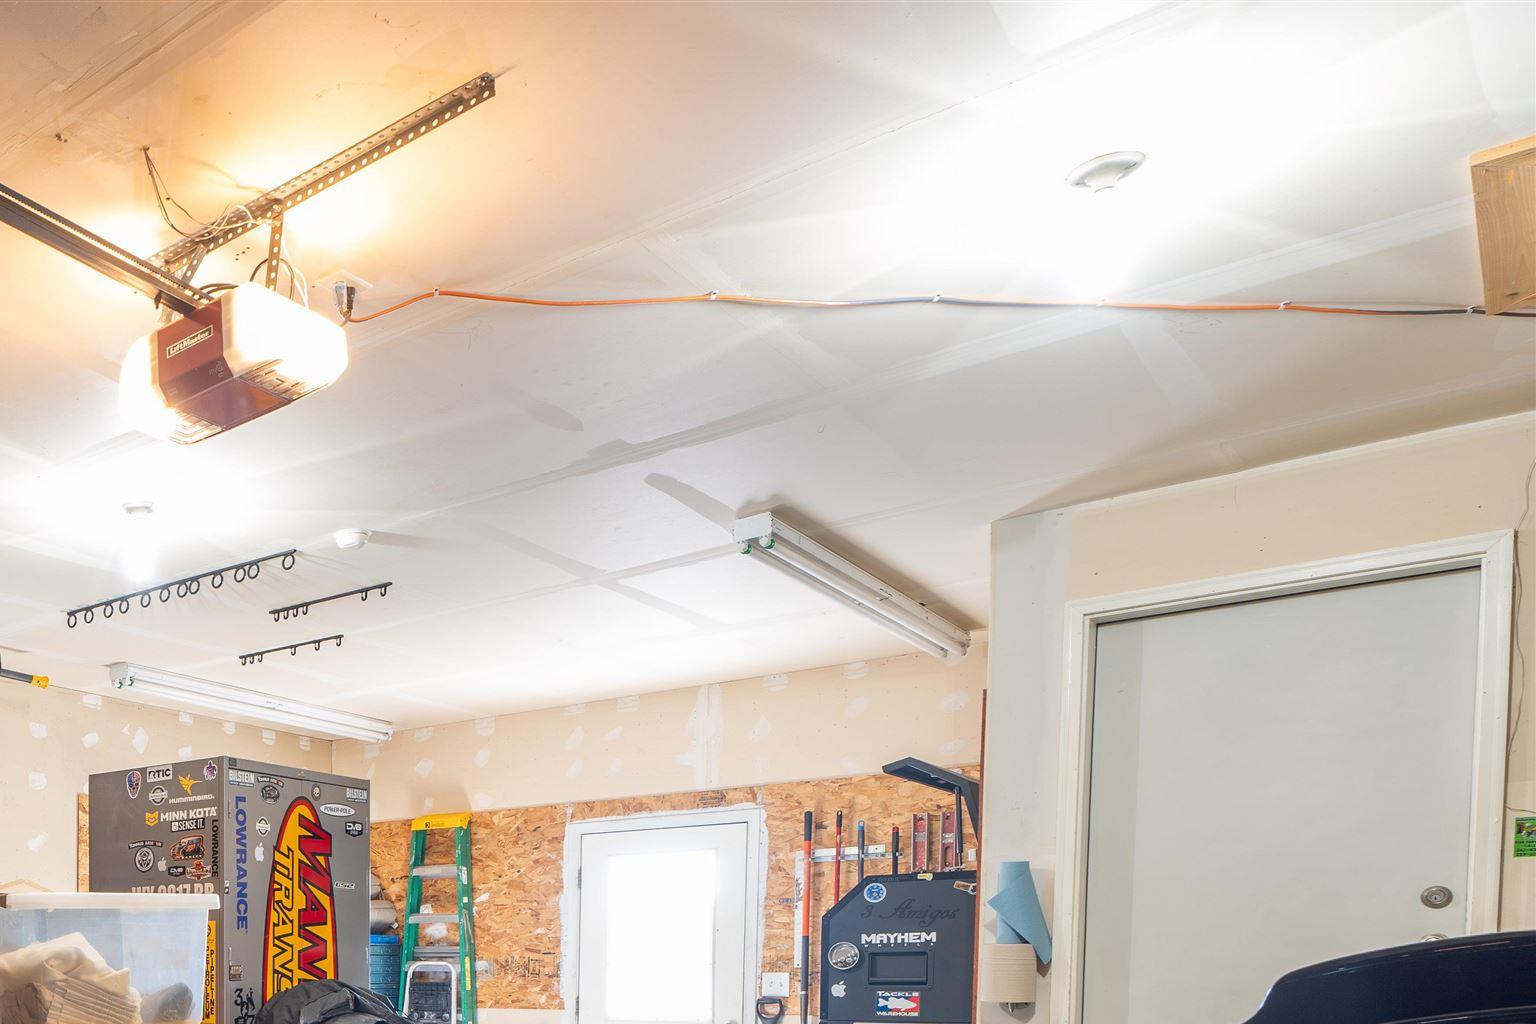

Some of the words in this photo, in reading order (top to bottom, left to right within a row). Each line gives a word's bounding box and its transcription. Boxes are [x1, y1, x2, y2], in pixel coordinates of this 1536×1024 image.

[148, 768, 172, 780] RTIC
[229, 769, 255, 784] BILSTEIN
[168, 793, 215, 804] HUMMINBIRD
[346, 787, 368, 800] BILSTEIN
[160, 809, 187, 822] MINN
[189, 806, 217, 820] KOTA
[323, 805, 352, 815] POWER-POLE
[178, 820, 197, 831] SENSE
[211, 819, 219, 878] LOWRANCE
[235, 796, 248, 930] LOWRANCE
[879, 898, 961, 927] Amigos
[861, 931, 937, 944] MAYHEM
